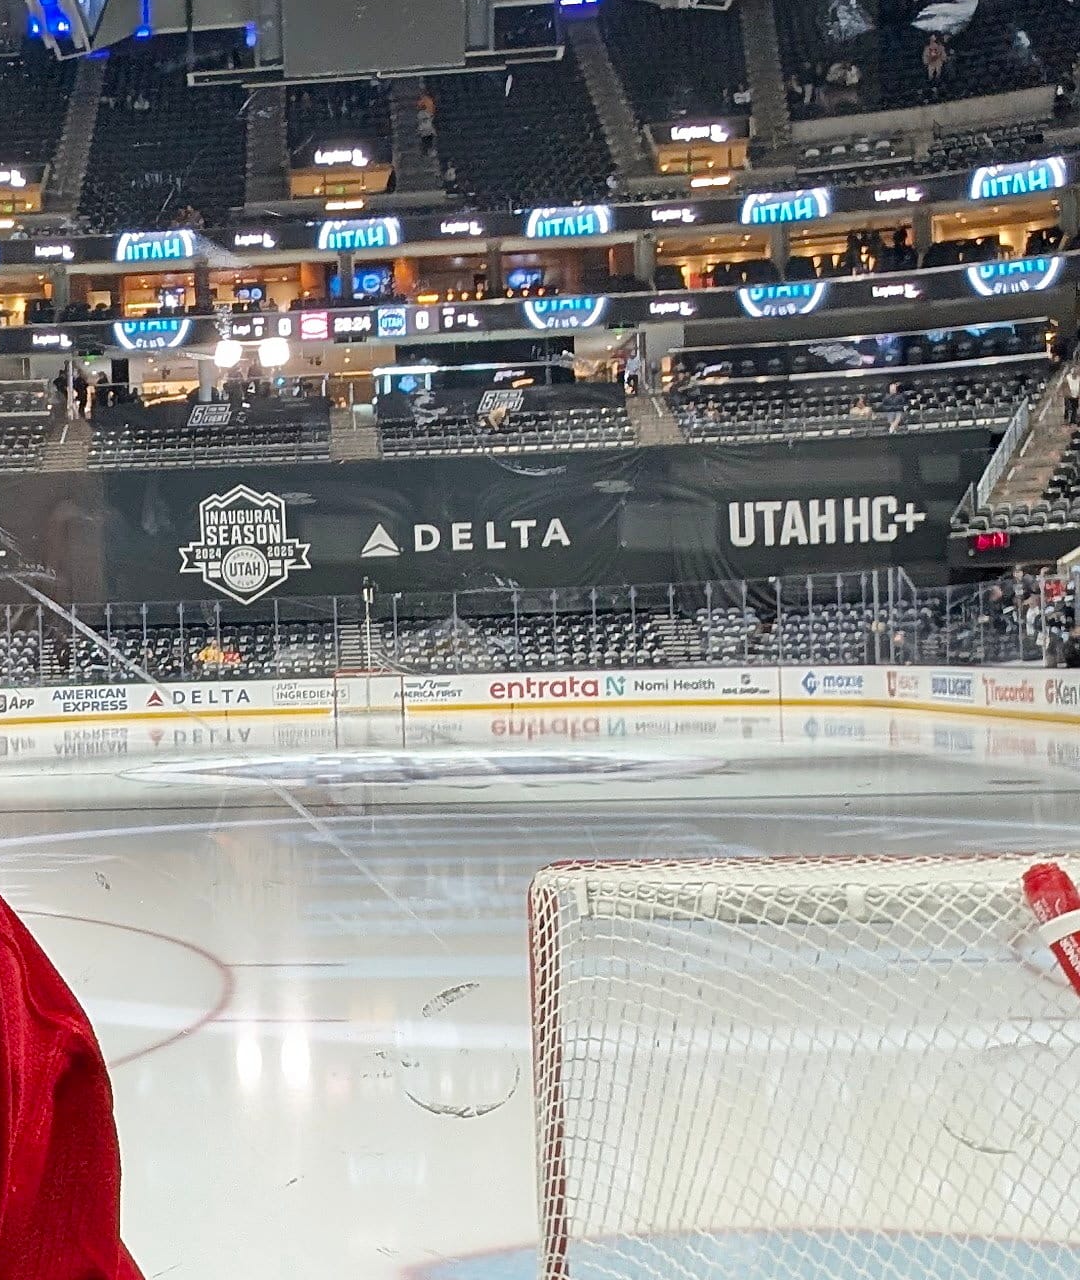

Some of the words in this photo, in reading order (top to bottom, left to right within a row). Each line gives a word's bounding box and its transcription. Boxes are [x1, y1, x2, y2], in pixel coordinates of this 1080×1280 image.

[279, 318, 291, 336] 0
[382, 317, 402, 329] UTAH
[416, 311, 429, 329] 0
[205, 509, 280, 525] INAUGURAL
[729, 499, 835, 548] UTAH
[843, 495, 927, 544] HC+
[206, 524, 280, 545] SEASON
[414, 518, 571, 553] DELTA
[195, 548, 221, 559] 2024
[267, 546, 294, 557] 2025
[229, 562, 260, 577] UTAH
[276, 683, 298, 691] JUST
[490, 675, 599, 699] entrata
[634, 679, 668, 692] Nomi
[673, 677, 715, 691] Health
[823, 675, 863, 688] moxie
[948, 677, 972, 696] LIGHT
[52, 687, 126, 702] AMERICAN
[173, 689, 251, 705] DELTA
[276, 688, 347, 700] INGREDIENTS
[436, 689, 463, 699] FIRST
[63, 699, 128, 713] EXPRESS
